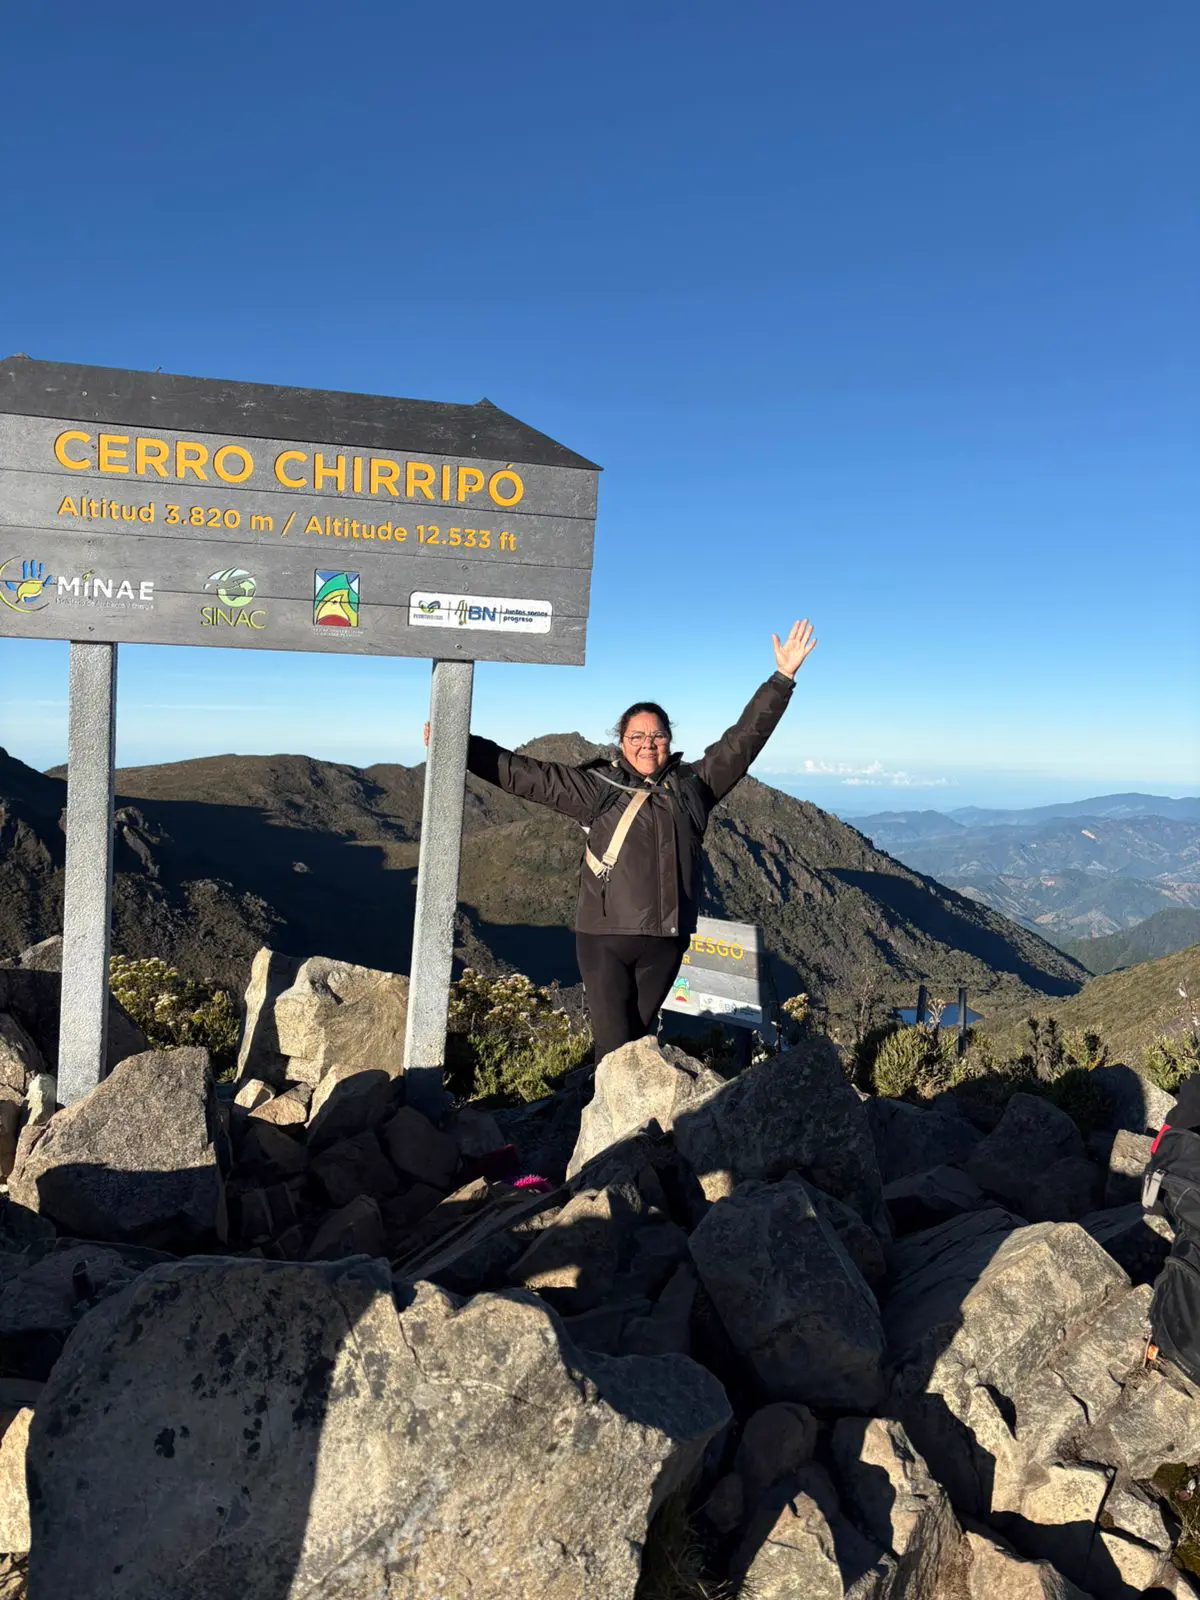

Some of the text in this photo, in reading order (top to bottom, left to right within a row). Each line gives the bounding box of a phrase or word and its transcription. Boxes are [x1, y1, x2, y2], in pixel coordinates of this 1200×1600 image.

[54, 429, 523, 507] CERRO CHIRRIPÓ
[57, 496, 517, 551] Altitud 3.820 m / Altitude 12.533 ft
[200, 607, 265, 629] SINAC
[468, 605, 497, 622] BN
[503, 615, 533, 623] progreso
[689, 934, 744, 960] IESGO
